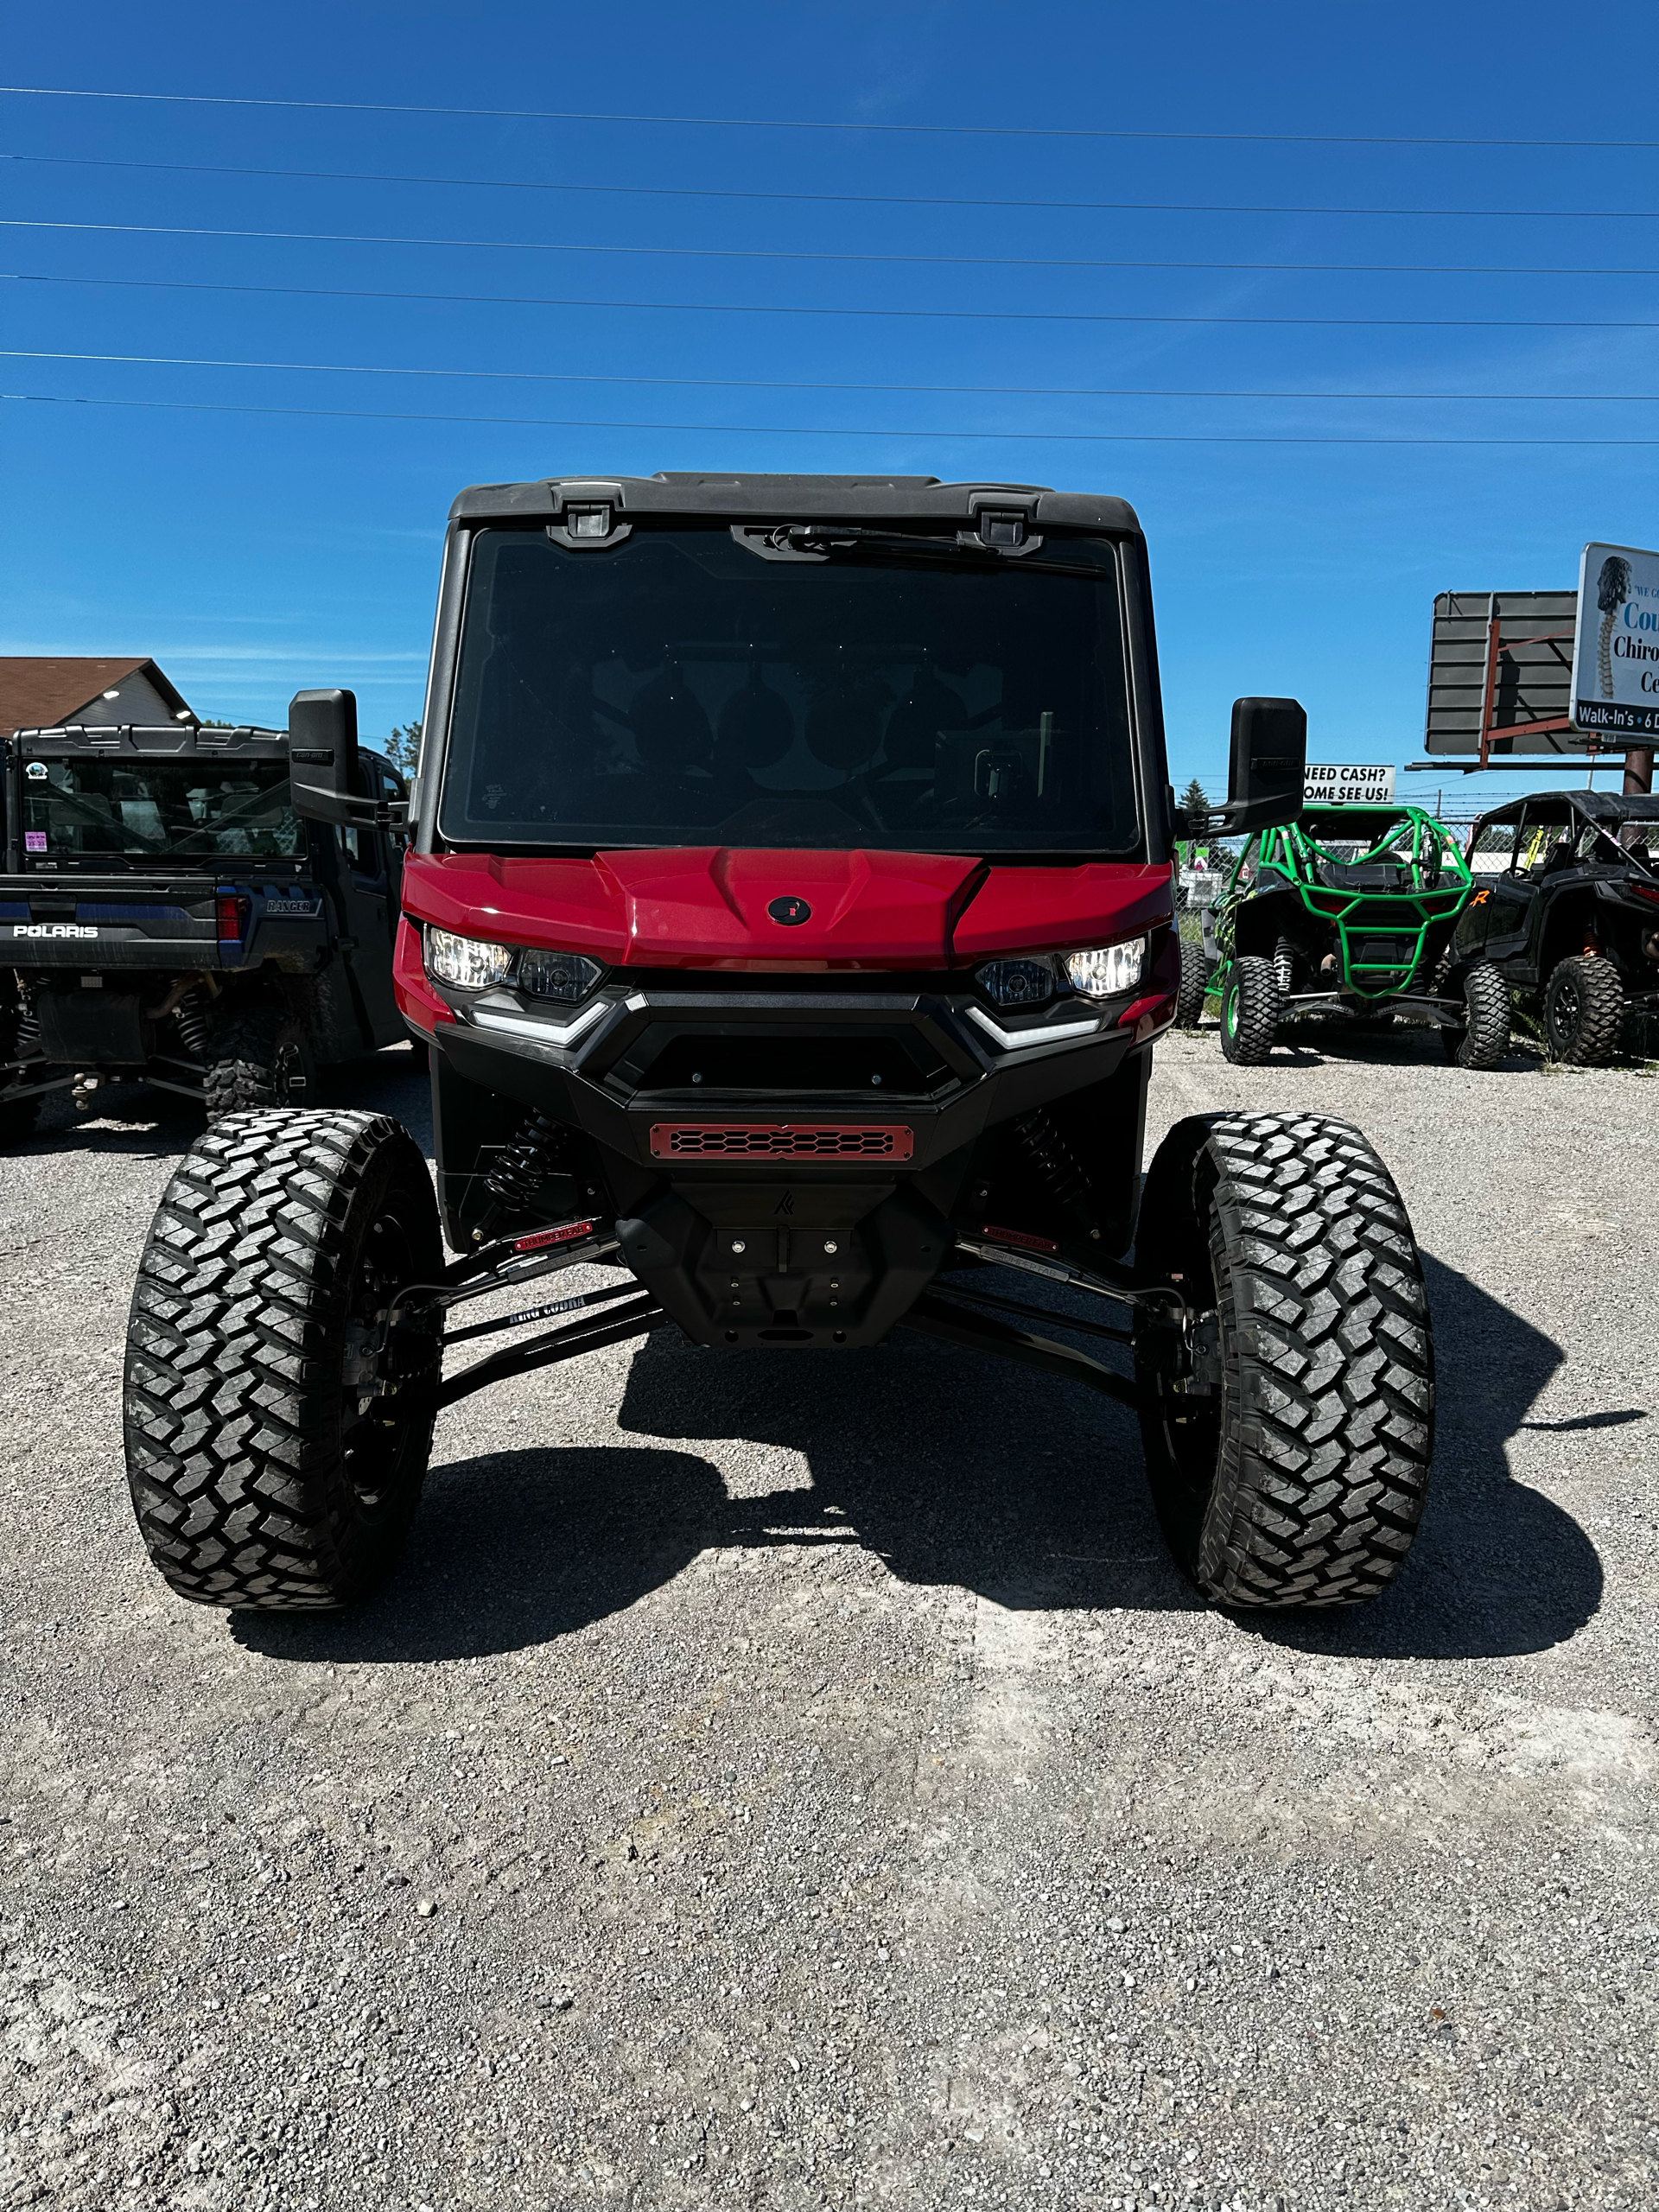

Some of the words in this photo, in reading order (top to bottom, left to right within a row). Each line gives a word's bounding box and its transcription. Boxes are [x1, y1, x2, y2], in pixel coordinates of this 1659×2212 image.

[1579, 706, 1635, 727] Walk-In's
[1644, 713, 1652, 728] 6
[1340, 767, 1386, 782] CASH?
[1303, 785, 1336, 800] OME
[1338, 786, 1363, 800] SEE
[1364, 787, 1389, 801] US!
[266, 899, 310, 912] RANGER
[13, 925, 99, 938] POLARIS
[523, 1230, 566, 1248] THUMPER
[566, 1225, 585, 1236] FAB
[990, 1228, 1033, 1244] THUMPER
[1033, 1238, 1051, 1249] FAB
[522, 1255, 568, 1277] THUMPER
[568, 1249, 588, 1261] FAB
[994, 1251, 1037, 1271] THUMPER
[1037, 1263, 1057, 1276] FAB
